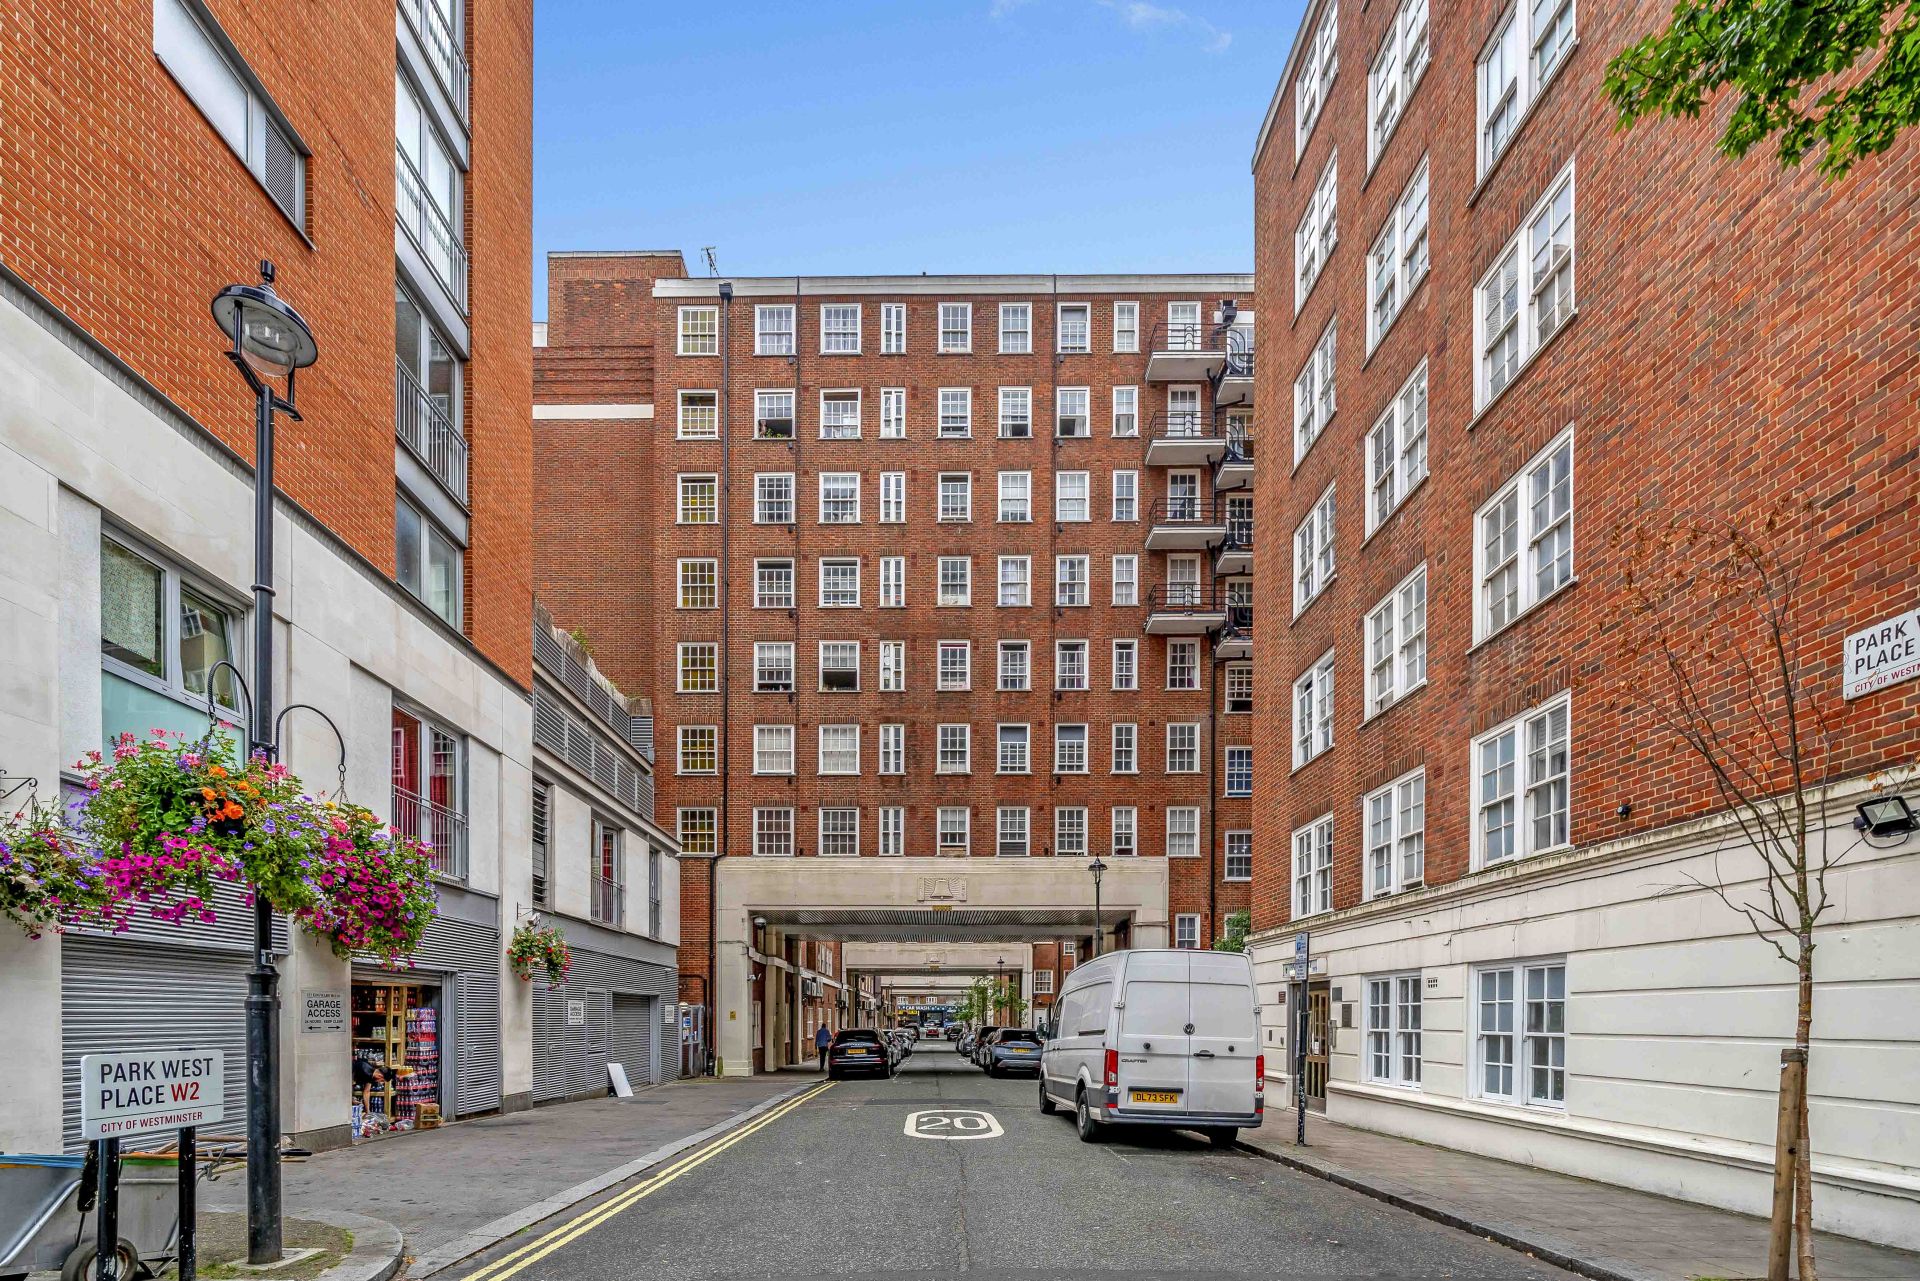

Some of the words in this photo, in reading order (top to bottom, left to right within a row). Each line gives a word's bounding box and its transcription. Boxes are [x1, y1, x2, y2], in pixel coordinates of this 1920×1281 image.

[1855, 620, 1908, 655] PARK
[1855, 637, 1915, 675] PLACE
[1855, 680, 1873, 693] CITY
[1877, 674, 1888, 685] OF
[306, 999, 341, 1009] GARAGE
[307, 1009, 341, 1018] ACCESS
[100, 1061, 156, 1084] PARK
[161, 1058, 213, 1079] WEST
[101, 1084, 165, 1110] PLACE
[171, 1081, 200, 1103] W2
[1136, 1093, 1158, 1102] DL73
[1158, 1094, 1175, 1102] SFK
[101, 1120, 123, 1134] CITY
[125, 1119, 138, 1130] OF
[140, 1111, 203, 1129] WESTMINSTER
[917, 1116, 988, 1130] 20
